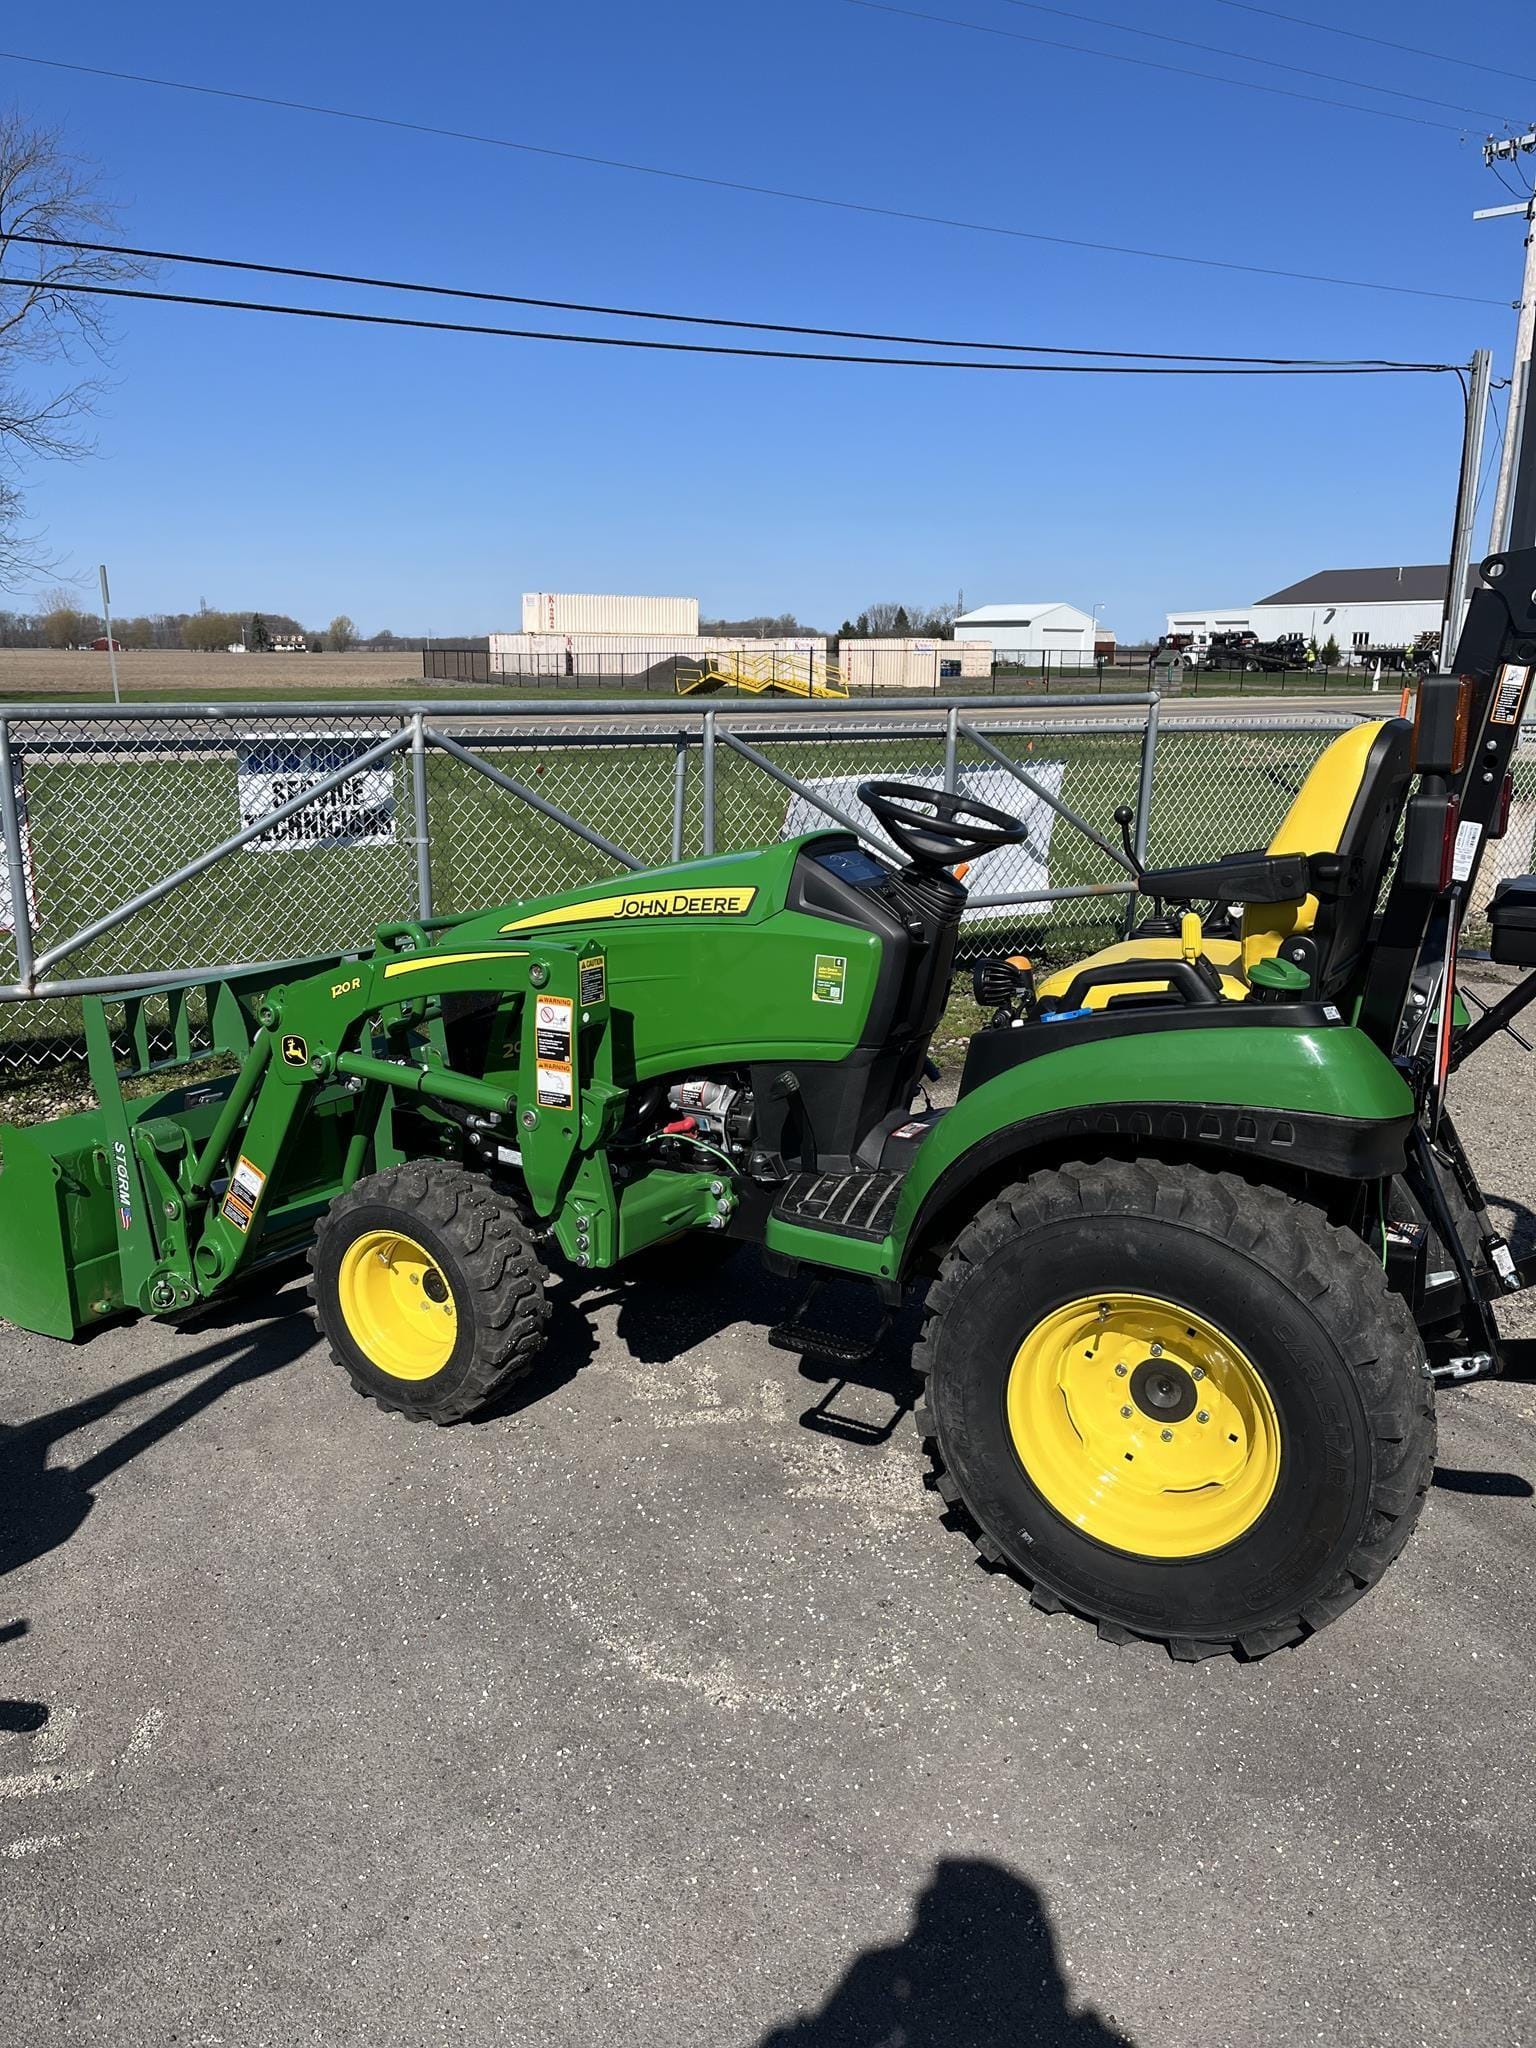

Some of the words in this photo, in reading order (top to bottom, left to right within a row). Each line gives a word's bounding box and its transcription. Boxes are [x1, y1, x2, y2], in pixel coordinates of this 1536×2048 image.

[614, 899, 667, 917] JOHN
[672, 896, 741, 914] DEERE
[586, 957, 603, 968] CAUTION
[331, 981, 351, 999] 120
[351, 977, 361, 990] R
[543, 997, 571, 1007] WARNING
[543, 1062, 571, 1073] WARNING
[114, 1141, 131, 1206] STORM
